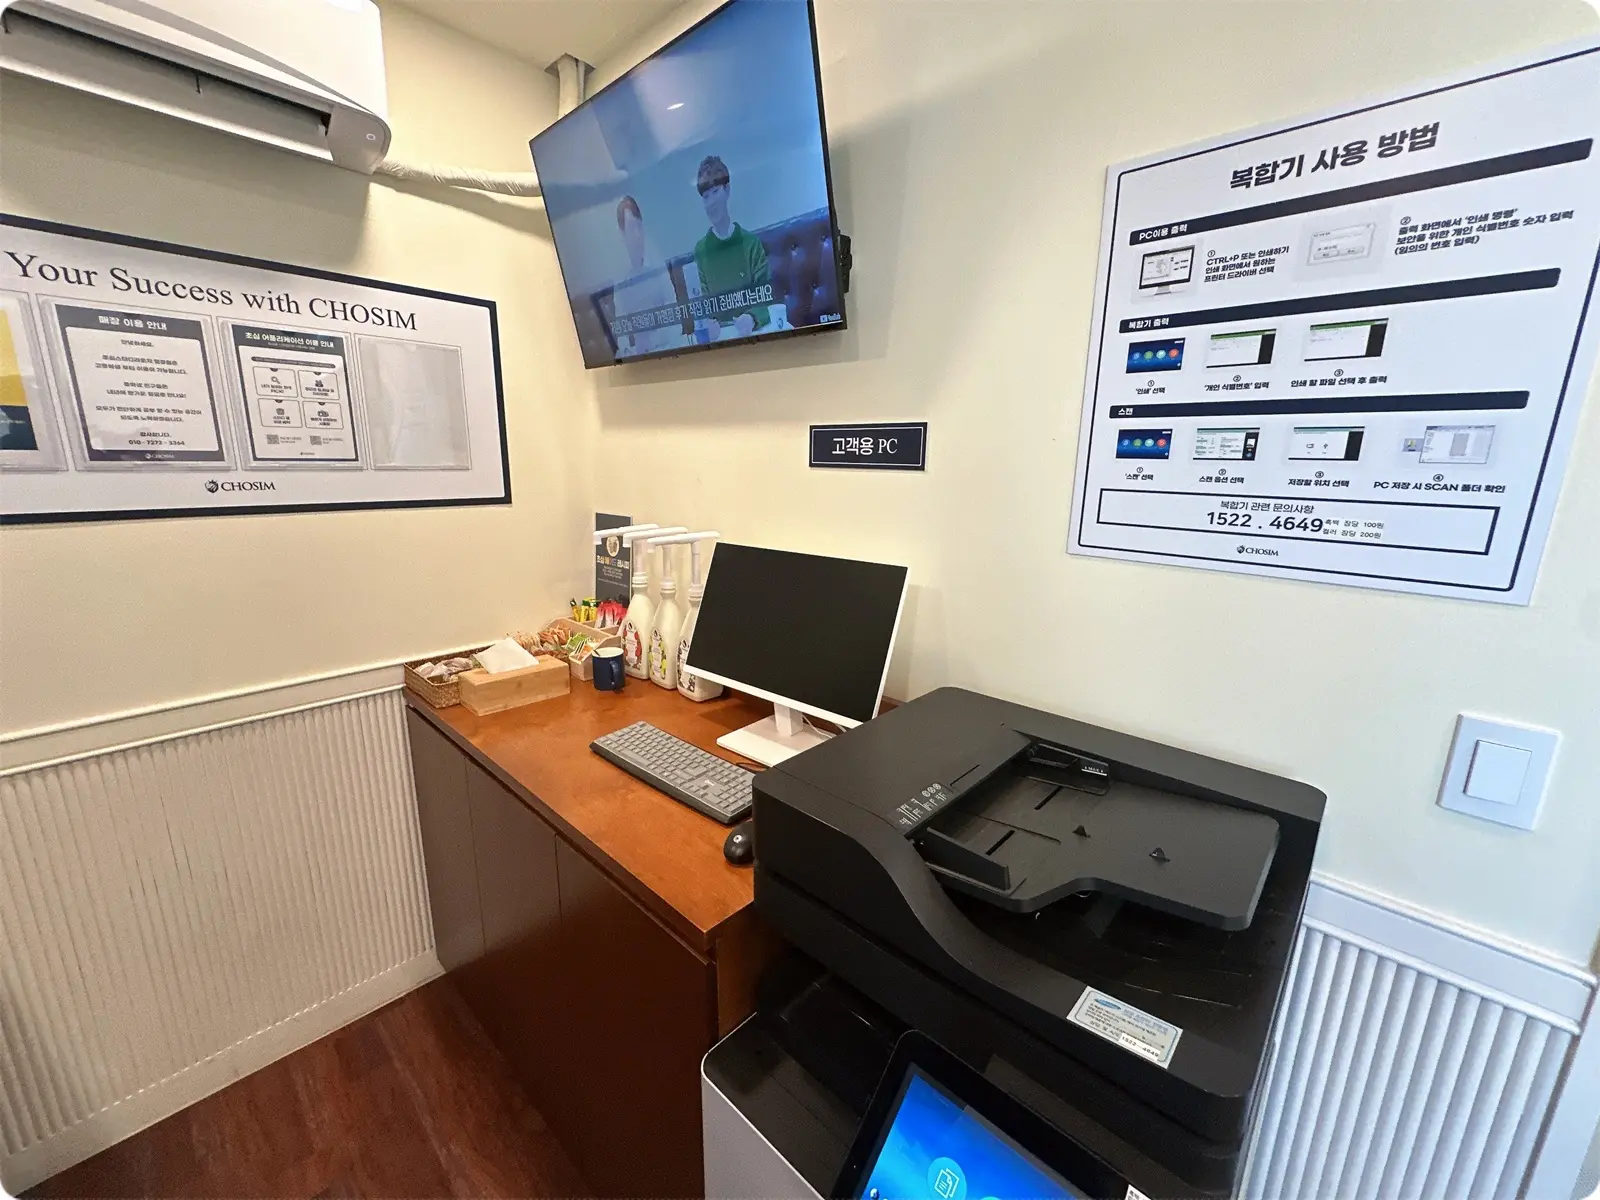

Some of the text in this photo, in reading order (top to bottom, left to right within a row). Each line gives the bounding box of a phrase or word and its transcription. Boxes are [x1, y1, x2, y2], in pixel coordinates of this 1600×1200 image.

[1230, 122, 1440, 189] 복합기 사용 방법
[1139, 224, 1188, 241] PC이용 출력
[1396, 209, 1575, 245] 보안을 위한 개인 식별번호 숫자 입력
[1399, 225, 1419, 235] 출력
[1420, 218, 1462, 231] 화면에서
[1394, 235, 1480, 256] (임의의 번호 입력)
[1206, 246, 1289, 266] CTRL+P 또는 인쇄하기
[1204, 265, 1275, 283] 프린터 드라이버 선택
[1205, 257, 1276, 275] 인쇄 화면에서 원하는
[3, 251, 418, 330] Your Success with CHOSIM
[674, 304, 688, 320] 후기
[688, 301, 703, 317] 직접
[703, 297, 719, 314] 읽기
[719, 284, 773, 311] 준비했다는데요
[123, 318, 144, 329] 이용
[146, 321, 167, 331] 안내
[1153, 317, 1169, 327] 출력
[245, 331, 260, 340] 초심
[262, 333, 304, 345] 어플리케이션
[320, 340, 335, 349] 안내
[1254, 381, 1270, 389] 입력
[1290, 380, 1307, 388] 인쇄
[1320, 378, 1336, 386] 파일
[1338, 377, 1356, 386] 선택
[1358, 376, 1367, 384] 후
[1368, 375, 1388, 384] 출력
[1152, 386, 1166, 394] 선택
[832, 437, 898, 456] 고객용 PC
[221, 481, 276, 492] CHOSIM
[1214, 476, 1229, 484] 옵션
[1230, 476, 1245, 485] 선택
[1287, 478, 1350, 488] 저장할 위치 선택
[1373, 481, 1506, 494] PC 저장 시 SCAN 폴더 확인
[1220, 500, 1315, 515] 복합기 관련 문의사항
[1206, 511, 1252, 528] 1522
[1269, 515, 1324, 533] 4649
[1324, 518, 1385, 530] 흑백 장당 100원
[1322, 528, 1382, 540] 컬러 장당 200원
[1245, 546, 1279, 557] CHOSIM
